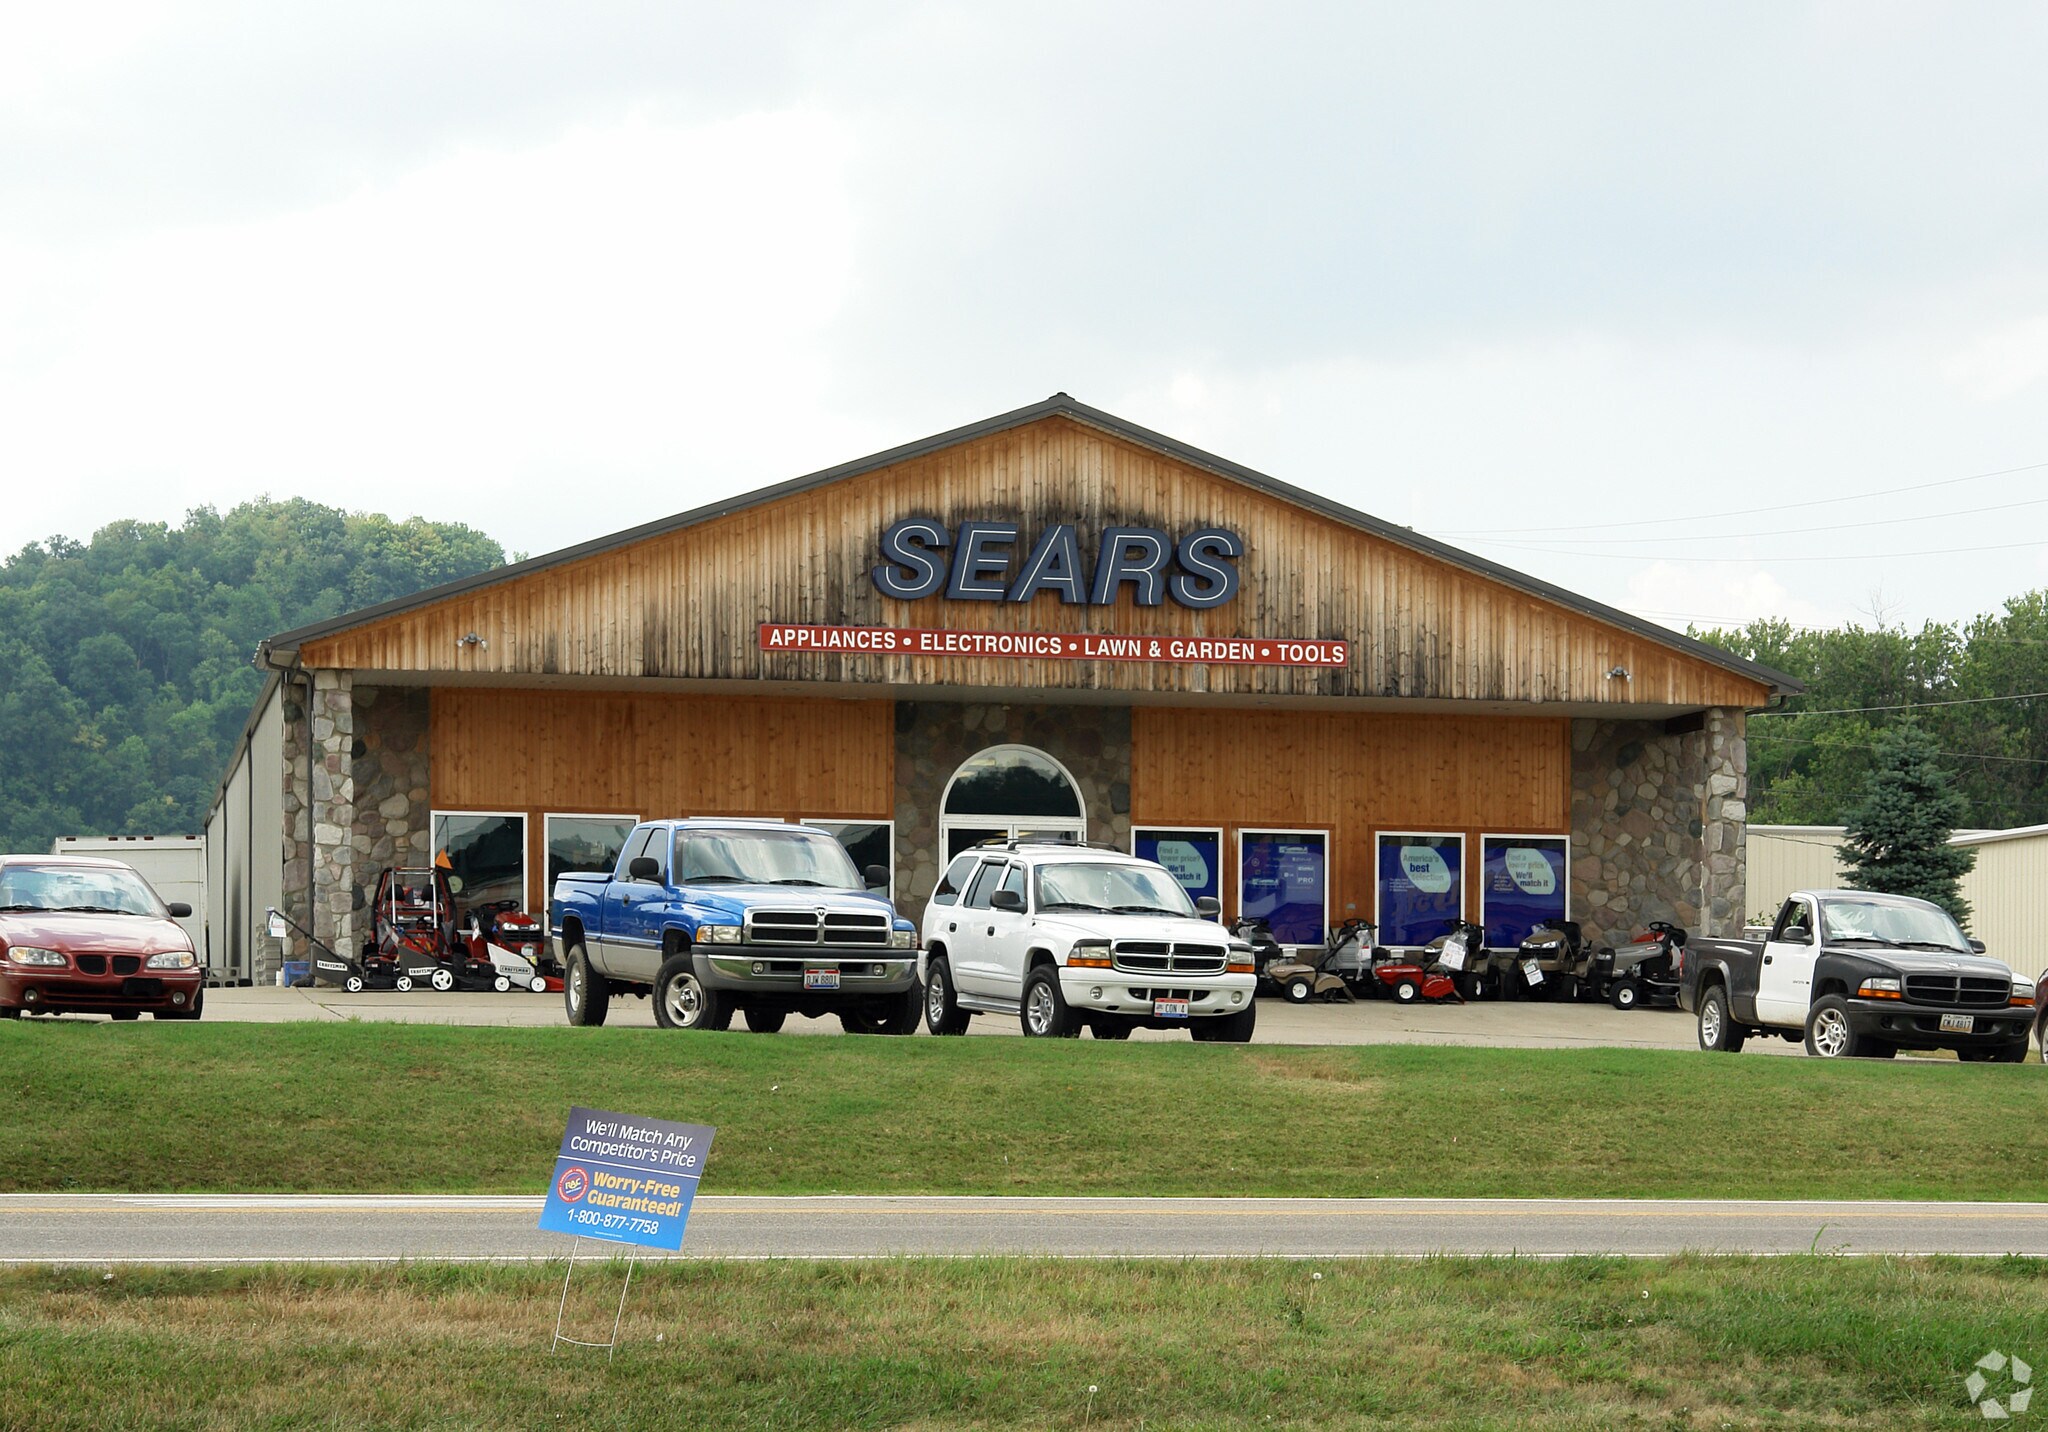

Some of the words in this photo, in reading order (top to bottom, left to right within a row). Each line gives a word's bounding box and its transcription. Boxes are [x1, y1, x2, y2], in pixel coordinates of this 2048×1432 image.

[871, 518, 1244, 609] SEARS
[769, 628, 896, 650] APPLIANCES
[920, 633, 1062, 655] ELECTRONICS
[1085, 638, 1141, 657] LAWN
[1149, 640, 1162, 658] &
[1170, 641, 1255, 660] GARDEN
[1277, 644, 1345, 664] TOOLS
[1403, 854, 1439, 863] America's
[1168, 864, 1185, 872] We'll
[1409, 863, 1430, 873] best
[1411, 873, 1444, 881] selection
[1515, 871, 1533, 879] We'll
[1520, 879, 1542, 887] match
[1543, 879, 1549, 887] it
[318, 962, 347, 970] CRAFTSMAN
[586, 1119, 617, 1138] We'll
[619, 1125, 662, 1144] Match
[665, 1133, 693, 1150] Any
[570, 1136, 658, 1162] Competitor's
[660, 1149, 696, 1168] Price
[593, 1171, 680, 1198] Worry-Free
[587, 1189, 683, 1217] Guaranteed!
[567, 1208, 659, 1235] 1-800-877-7758
